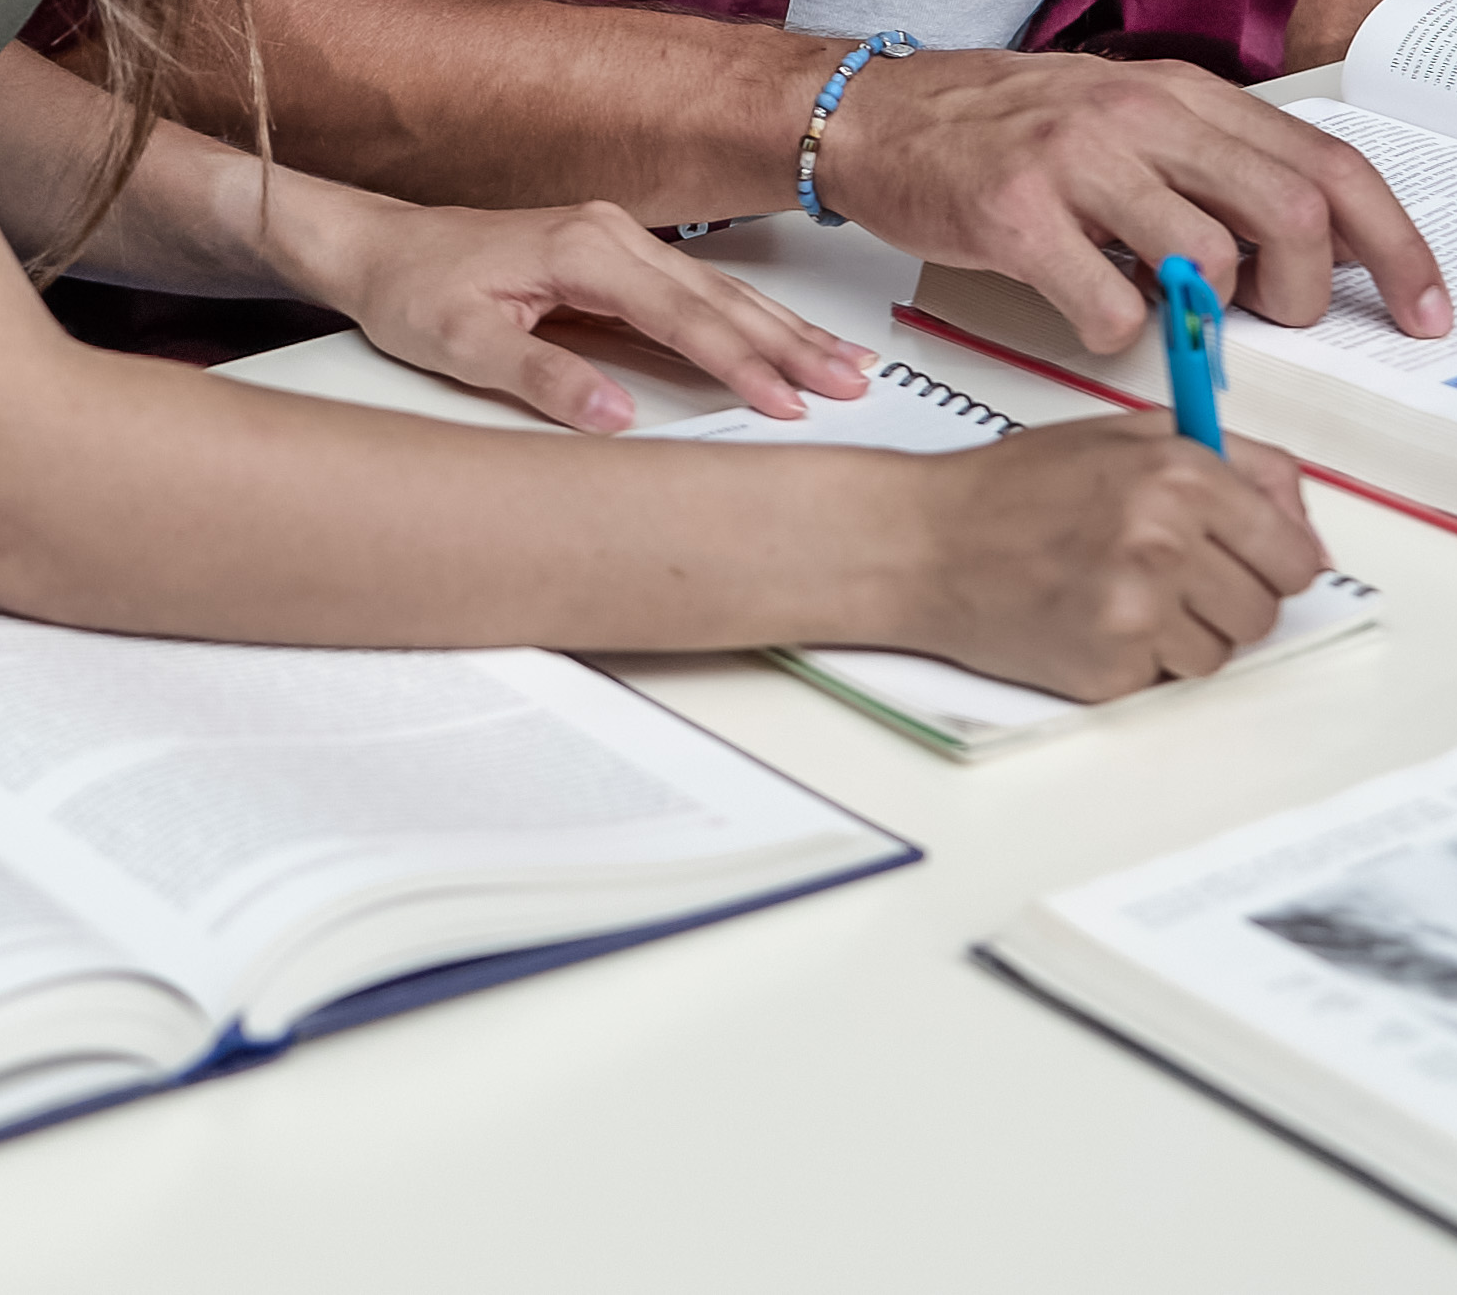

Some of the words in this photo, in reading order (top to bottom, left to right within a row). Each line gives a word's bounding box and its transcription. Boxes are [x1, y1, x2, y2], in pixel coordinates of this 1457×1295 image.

[1394, 24, 1421, 56] osmosi
[1399, 27, 1432, 76] concentra-
[1389, 56, 1401, 73] di-
[1409, 58, 1426, 81] essa
[1421, 38, 1451, 83] l'osmola-
